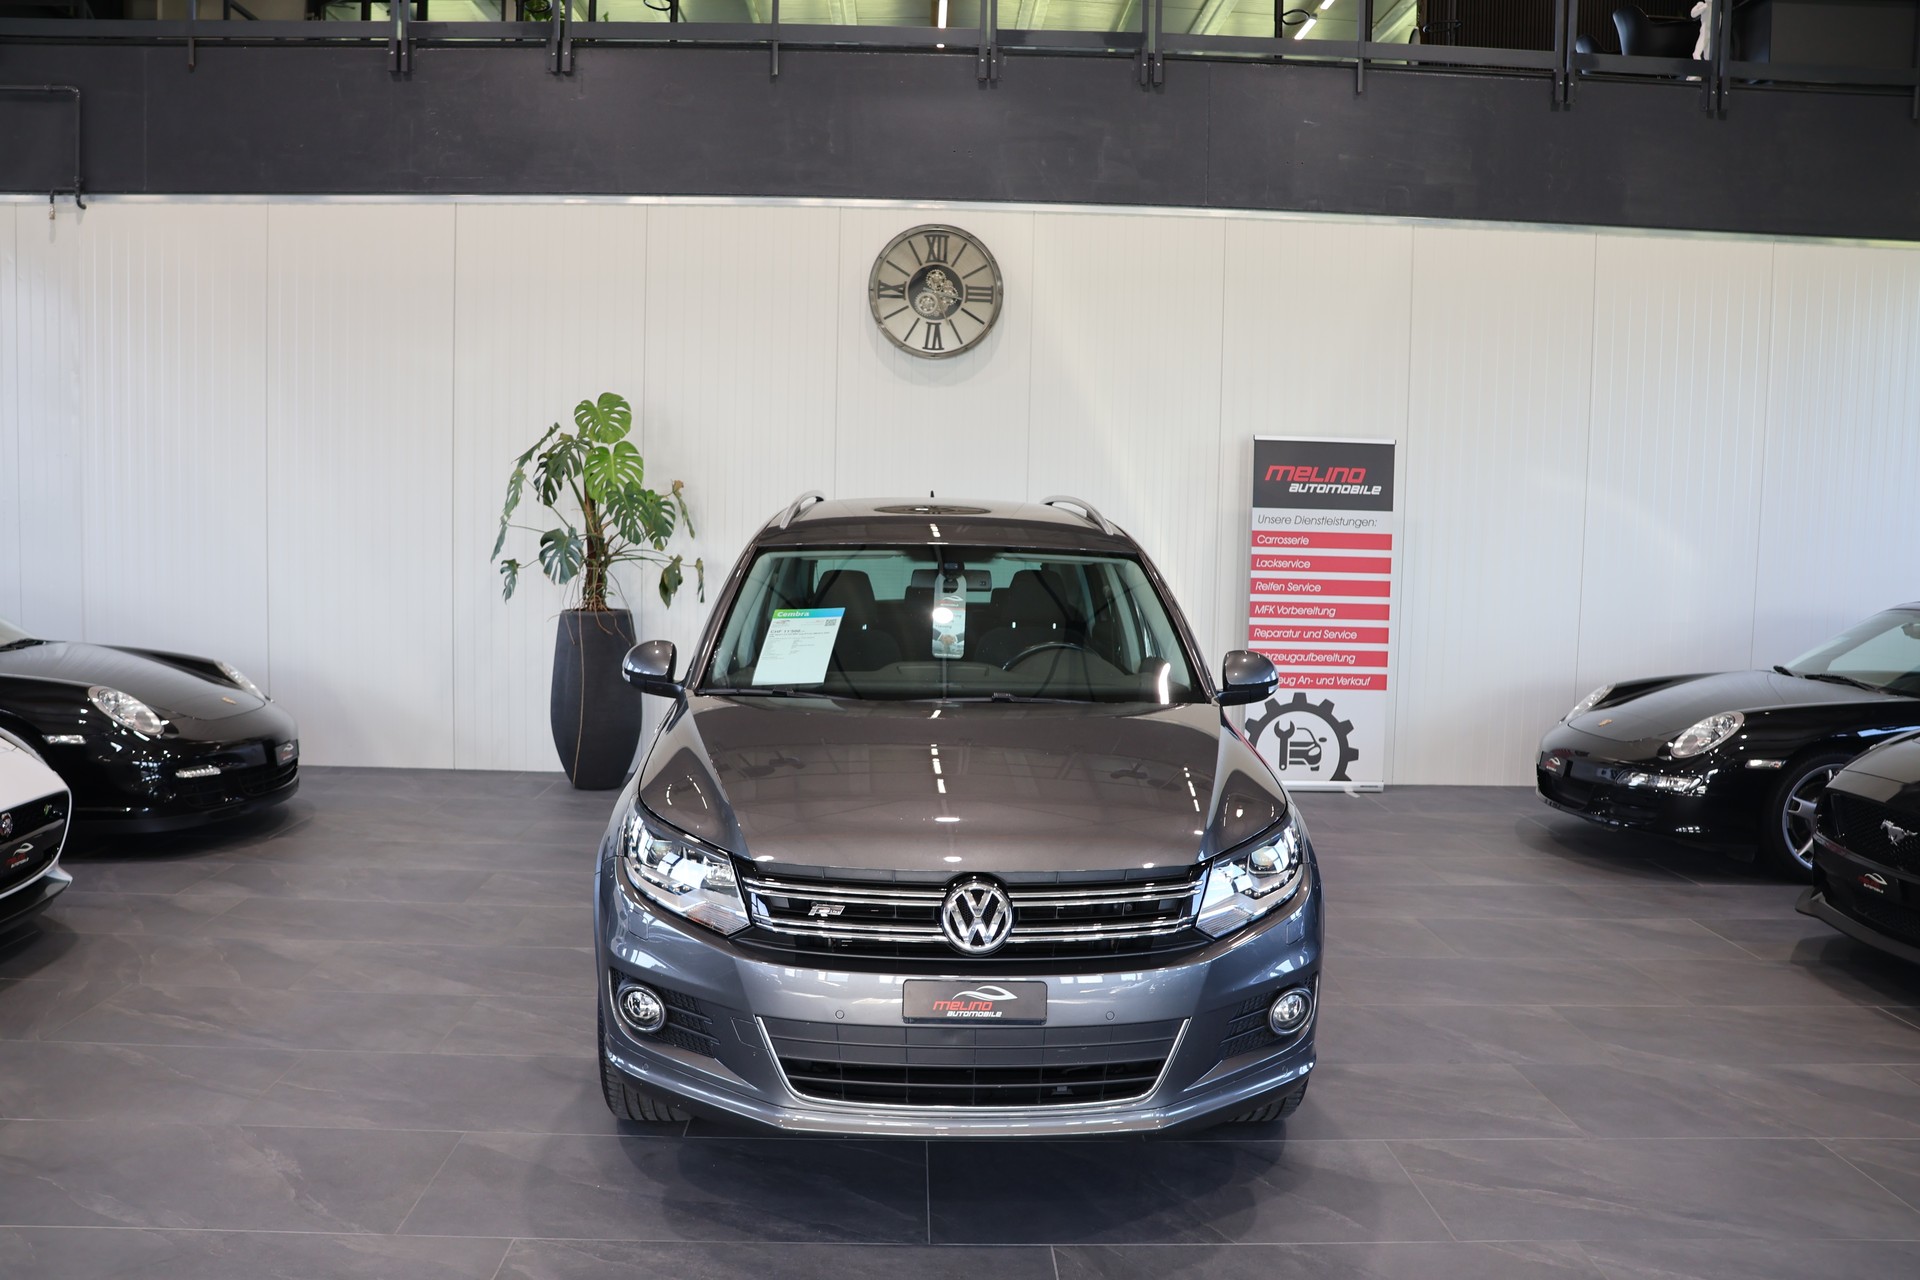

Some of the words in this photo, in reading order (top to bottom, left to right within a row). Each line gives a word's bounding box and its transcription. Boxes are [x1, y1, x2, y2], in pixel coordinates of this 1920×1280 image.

[924, 234, 950, 264] XII
[964, 283, 994, 305] III
[1257, 515, 1292, 525] Unsere
[1294, 515, 1378, 529] Dienstleistungen:
[1256, 534, 1310, 545] Carrosserie
[1256, 558, 1311, 569] Lackservice
[1255, 581, 1285, 592] Reifen
[1287, 582, 1322, 592] Service
[1254, 605, 1275, 615] MFK
[1277, 605, 1337, 617] Vorbereitung
[1253, 628, 1301, 640] Reparatur
[1303, 629, 1321, 639] und
[1323, 629, 1358, 640] Service
[1297, 675, 1314, 685] An-
[1316, 676, 1334, 685] und
[1336, 676, 1372, 687] Verkauf
